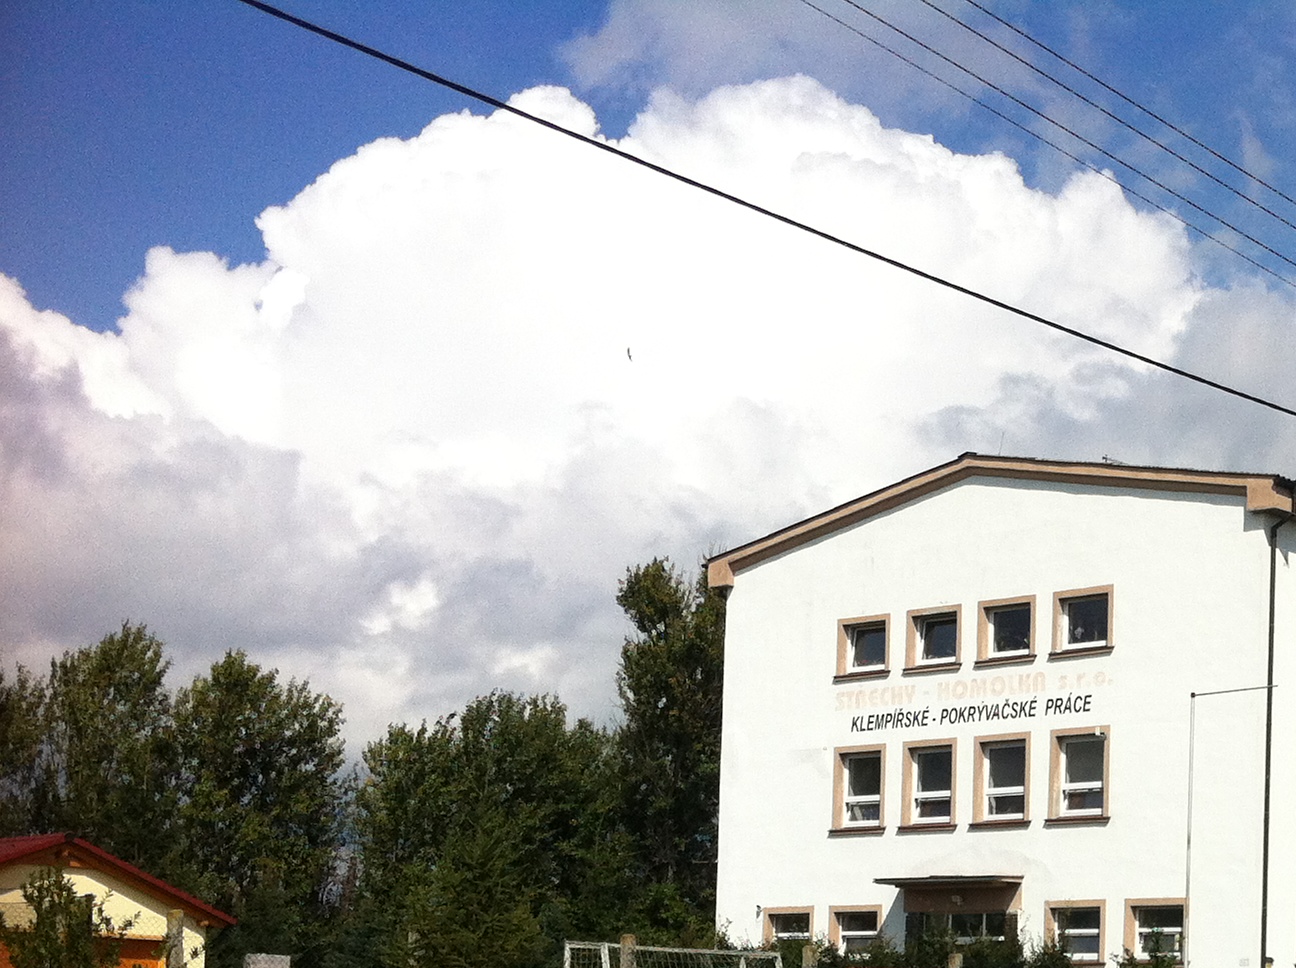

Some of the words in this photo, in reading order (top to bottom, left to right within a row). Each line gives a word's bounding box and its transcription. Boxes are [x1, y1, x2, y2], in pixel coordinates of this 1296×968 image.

[937, 671, 1047, 701] HOMOLKA
[851, 706, 930, 733] KLEMPÍŘSKÉ
[940, 695, 1038, 726] POKRÝVAČSKÉ
[1045, 692, 1093, 717] PRÁCE
